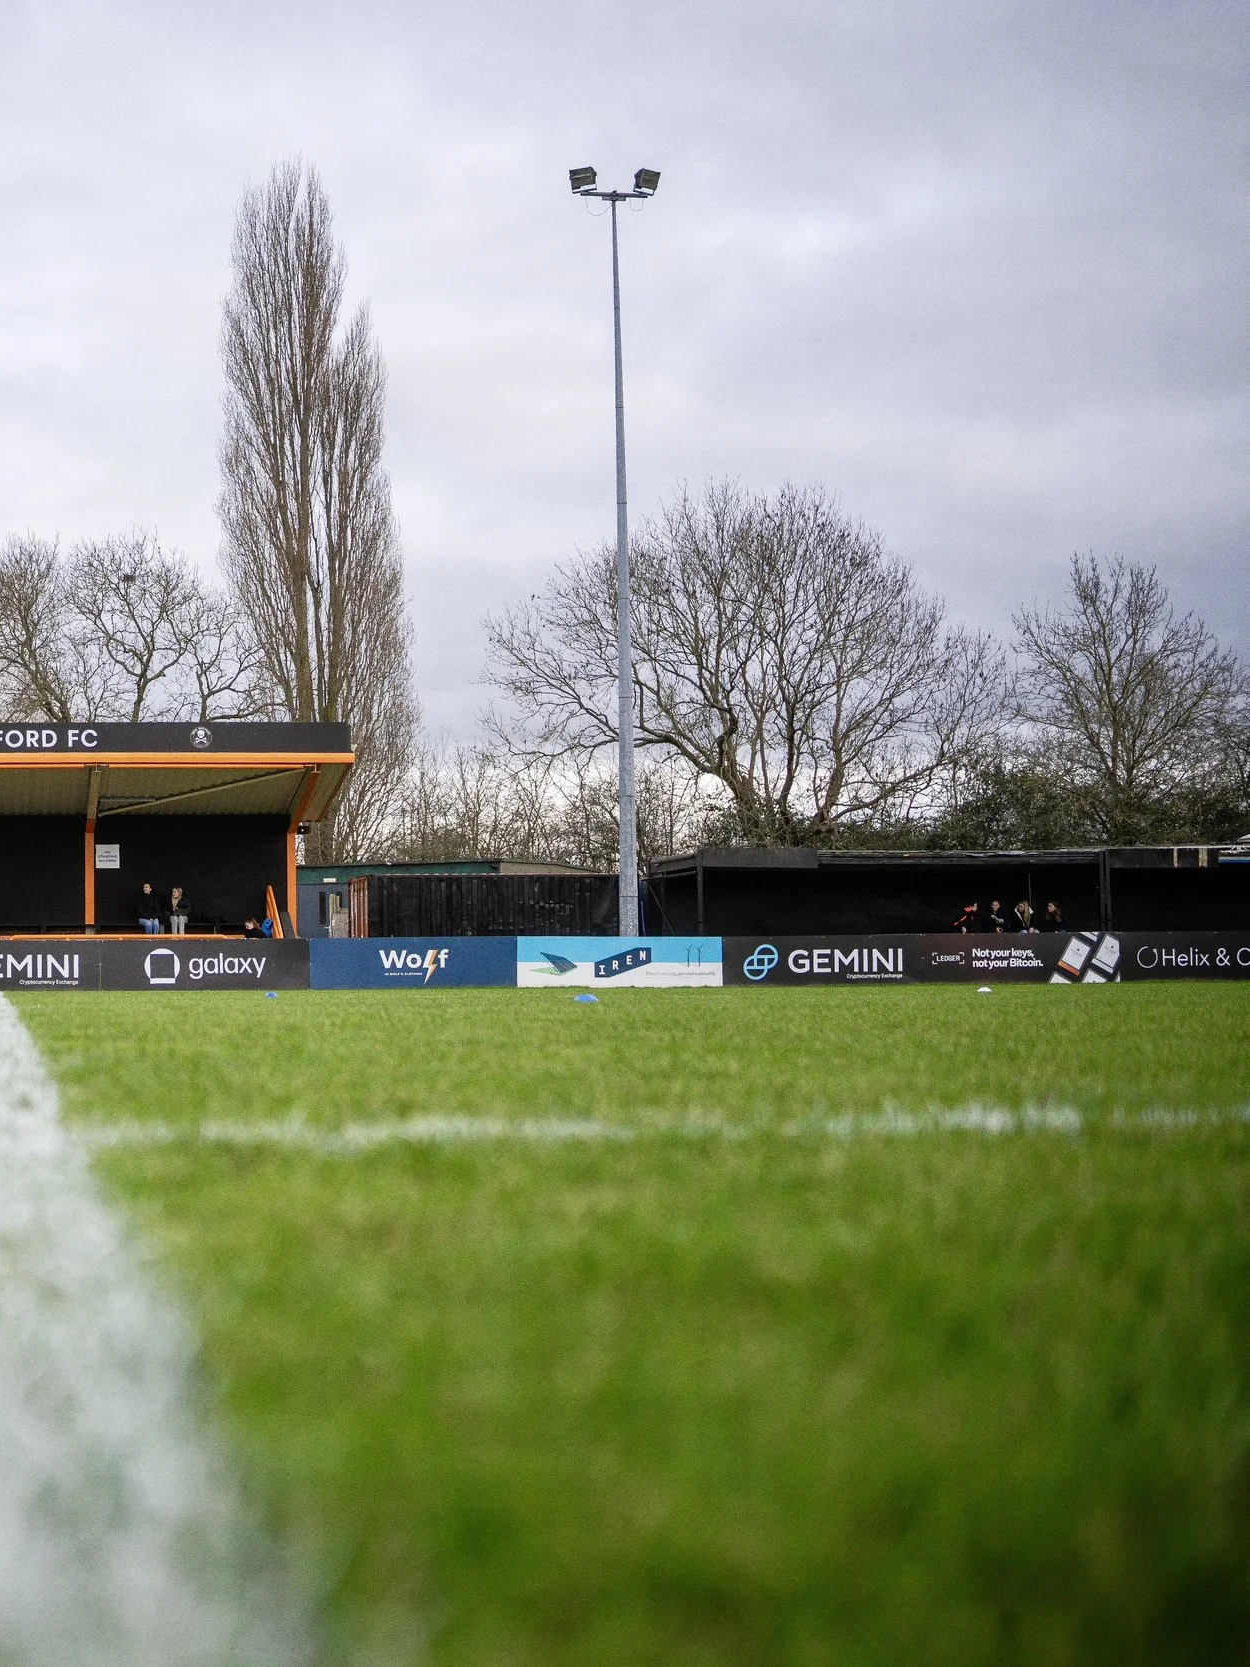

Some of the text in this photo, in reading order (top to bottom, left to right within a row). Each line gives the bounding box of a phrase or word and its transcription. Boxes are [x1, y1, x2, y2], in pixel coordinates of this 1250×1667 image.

[67, 729, 98, 748] FC
[598, 950, 647, 975] IREN
[787, 948, 903, 974] GEMINI
[972, 948, 1035, 960] Not your keys,
[972, 958, 1044, 970] not your Bitcoin.
[1162, 947, 1210, 966] Helix
[1216, 948, 1230, 966] &
[188, 952, 267, 980] galaxy
[378, 948, 450, 985] Wolf
